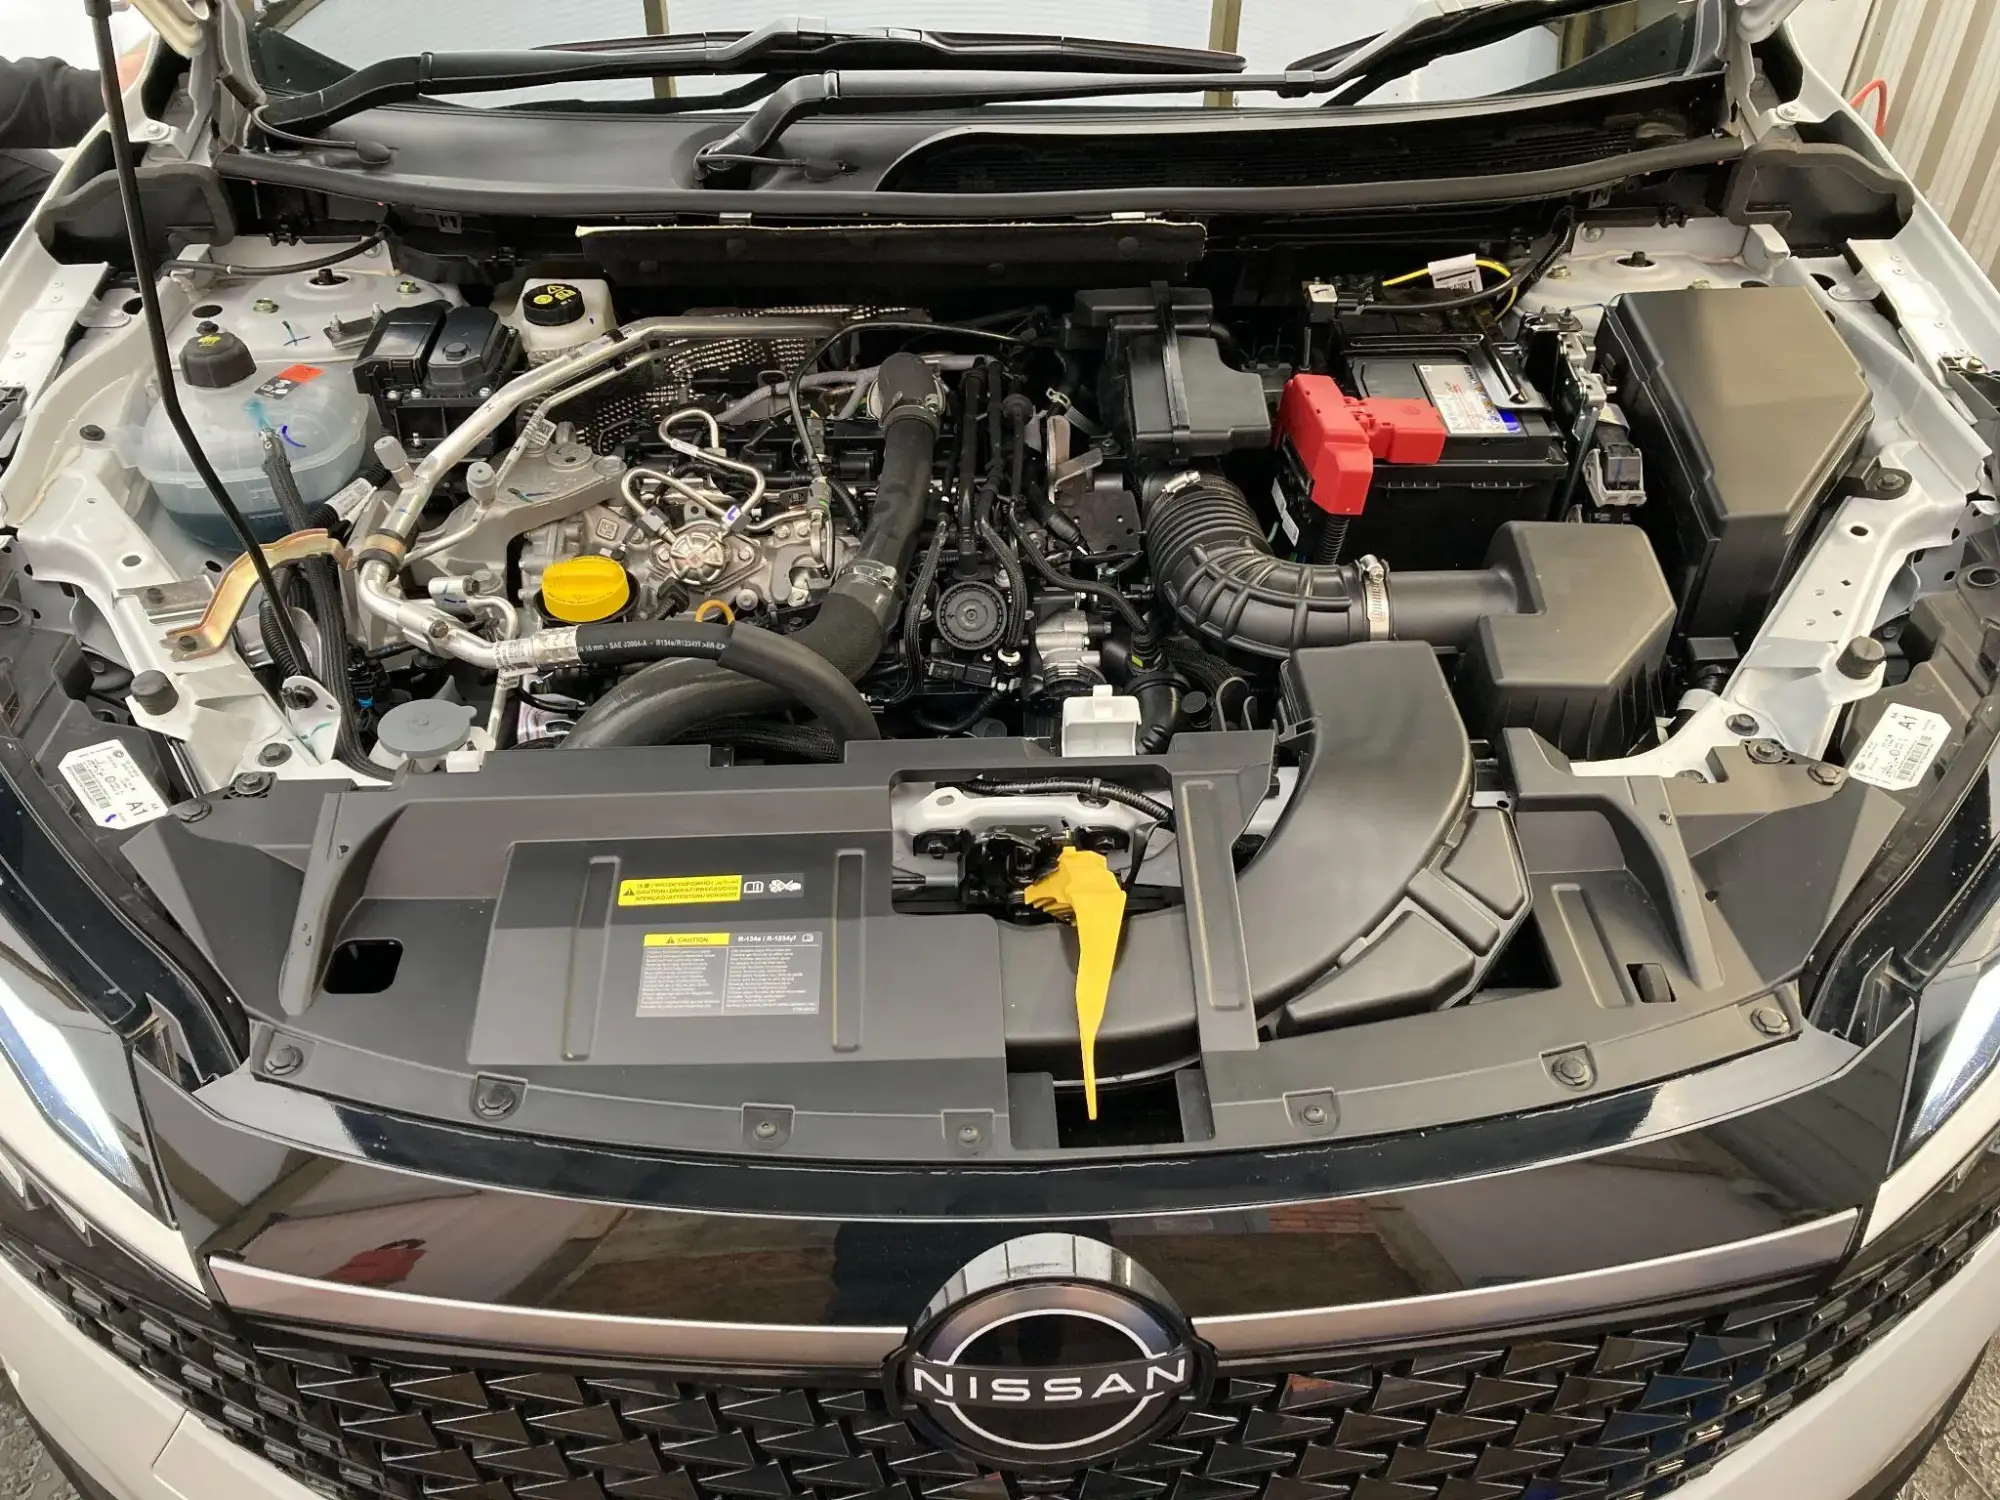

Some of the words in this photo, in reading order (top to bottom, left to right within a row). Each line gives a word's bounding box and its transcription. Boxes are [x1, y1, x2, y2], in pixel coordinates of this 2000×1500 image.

[609, 641, 622, 649] SAE
[1897, 715, 1918, 730] A1
[126, 800, 148, 817] A1
[913, 1358, 1186, 1402] NISSAN
